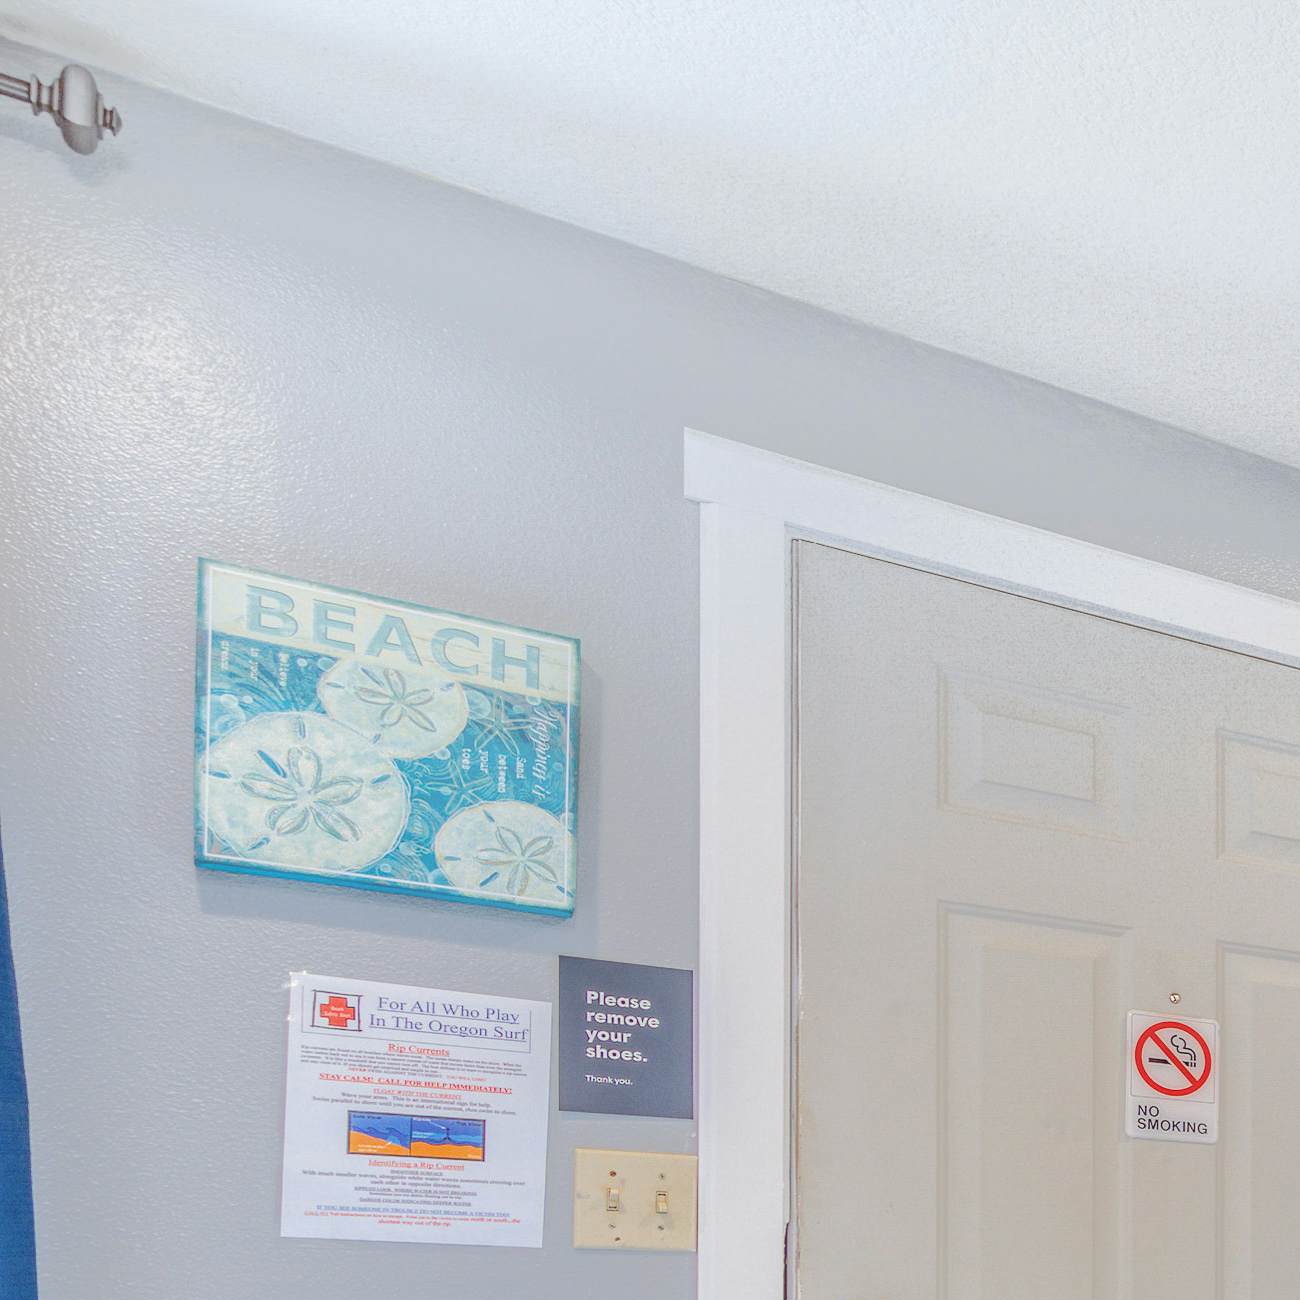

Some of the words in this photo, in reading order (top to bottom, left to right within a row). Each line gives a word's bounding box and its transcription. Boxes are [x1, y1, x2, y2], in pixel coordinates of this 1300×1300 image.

[245, 584, 542, 691] BEACH
[586, 990, 651, 1010] Please
[378, 996, 404, 1011] For
[410, 1001, 436, 1014] All
[442, 1005, 480, 1018] Who
[485, 1007, 520, 1024] Play
[586, 1010, 660, 1028] remove
[369, 1014, 386, 1028] In
[391, 1016, 424, 1031] The
[428, 1019, 488, 1038] Oregon
[493, 1025, 529, 1041] Surf
[585, 1028, 632, 1044] your
[388, 1043, 406, 1053] Rip
[408, 1044, 449, 1057] Currents
[586, 1045, 648, 1063] shoes.
[585, 1074, 613, 1085] Thank
[614, 1077, 634, 1086] you.
[1137, 1104, 1160, 1118] NO
[1137, 1117, 1208, 1135] SMOKING
